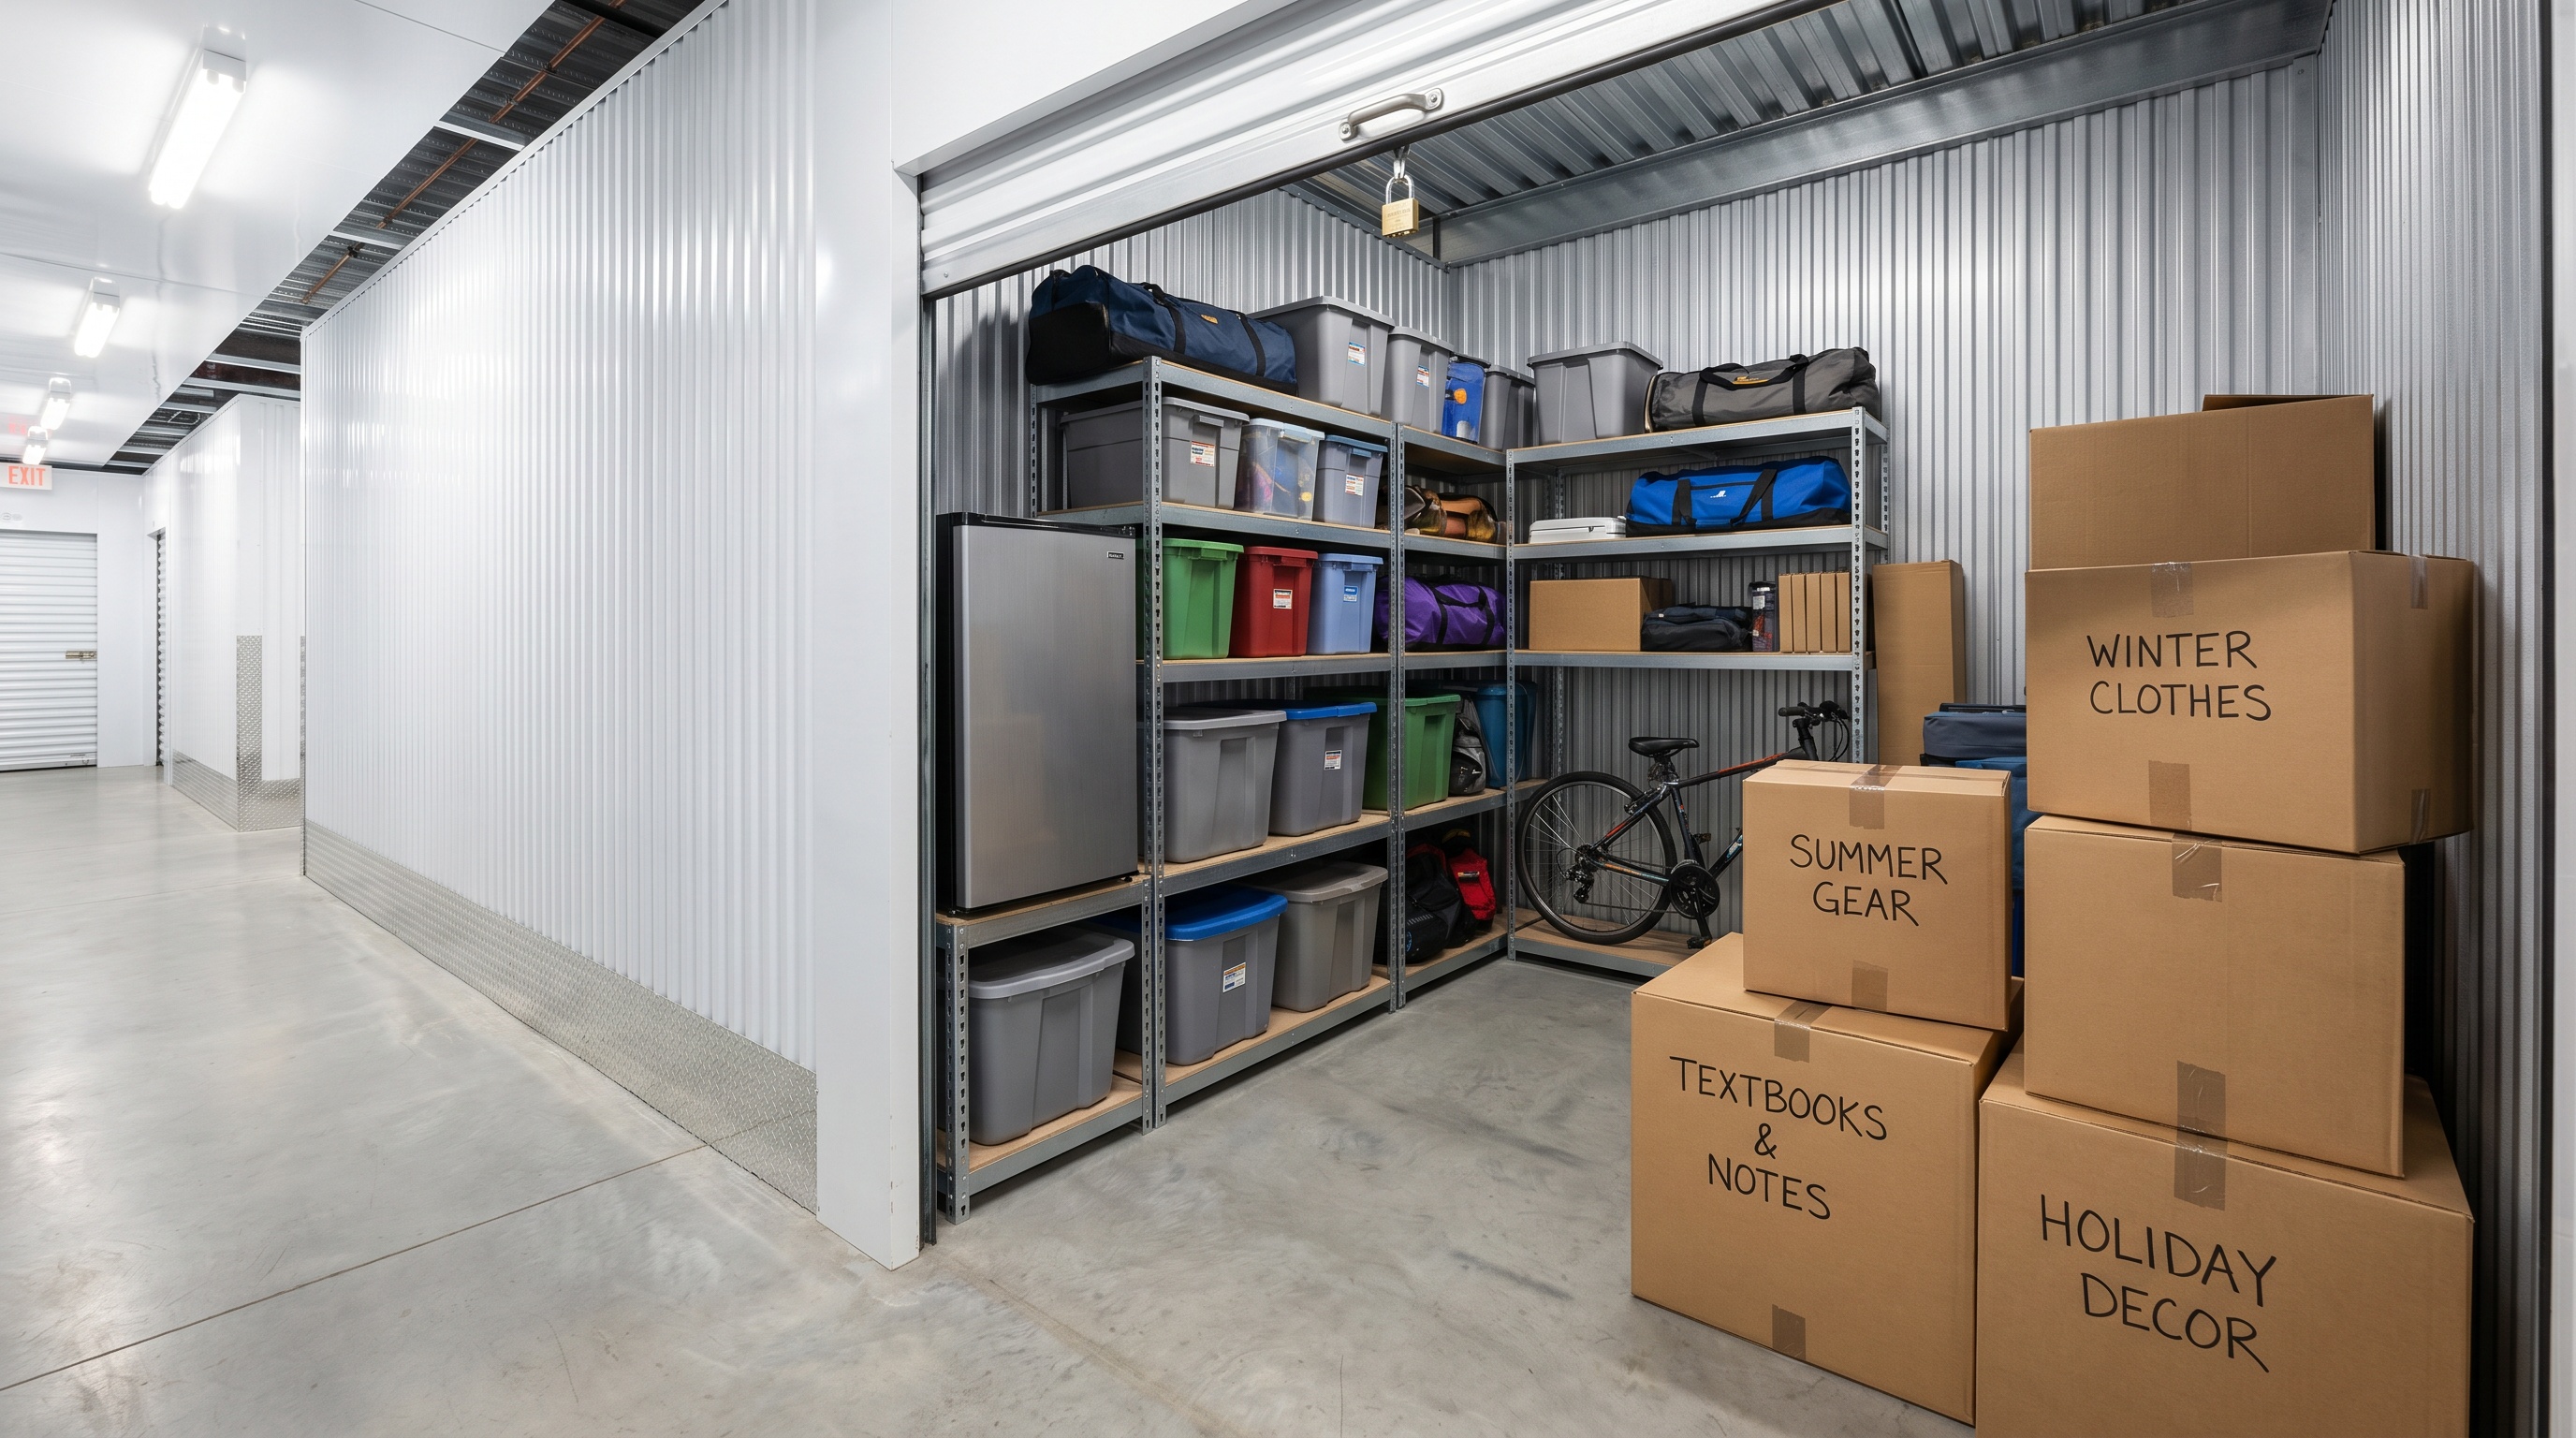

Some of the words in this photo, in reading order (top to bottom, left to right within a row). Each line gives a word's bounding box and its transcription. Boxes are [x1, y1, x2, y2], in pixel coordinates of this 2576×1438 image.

[8, 465, 46, 486] EXIT
[2086, 630, 2258, 669] WINTER
[2089, 680, 2272, 722] CLOTHES
[1789, 833, 1948, 886] SUMMER
[1812, 881, 1920, 927] GEAR
[1669, 1055, 1888, 1141] TEXTBOOKS
[1753, 1123, 1777, 1160] &
[1708, 1152, 1831, 1220] NOTES
[2041, 1194, 2277, 1308] HOLIDAY
[2080, 1272, 2270, 1374] DECOR
